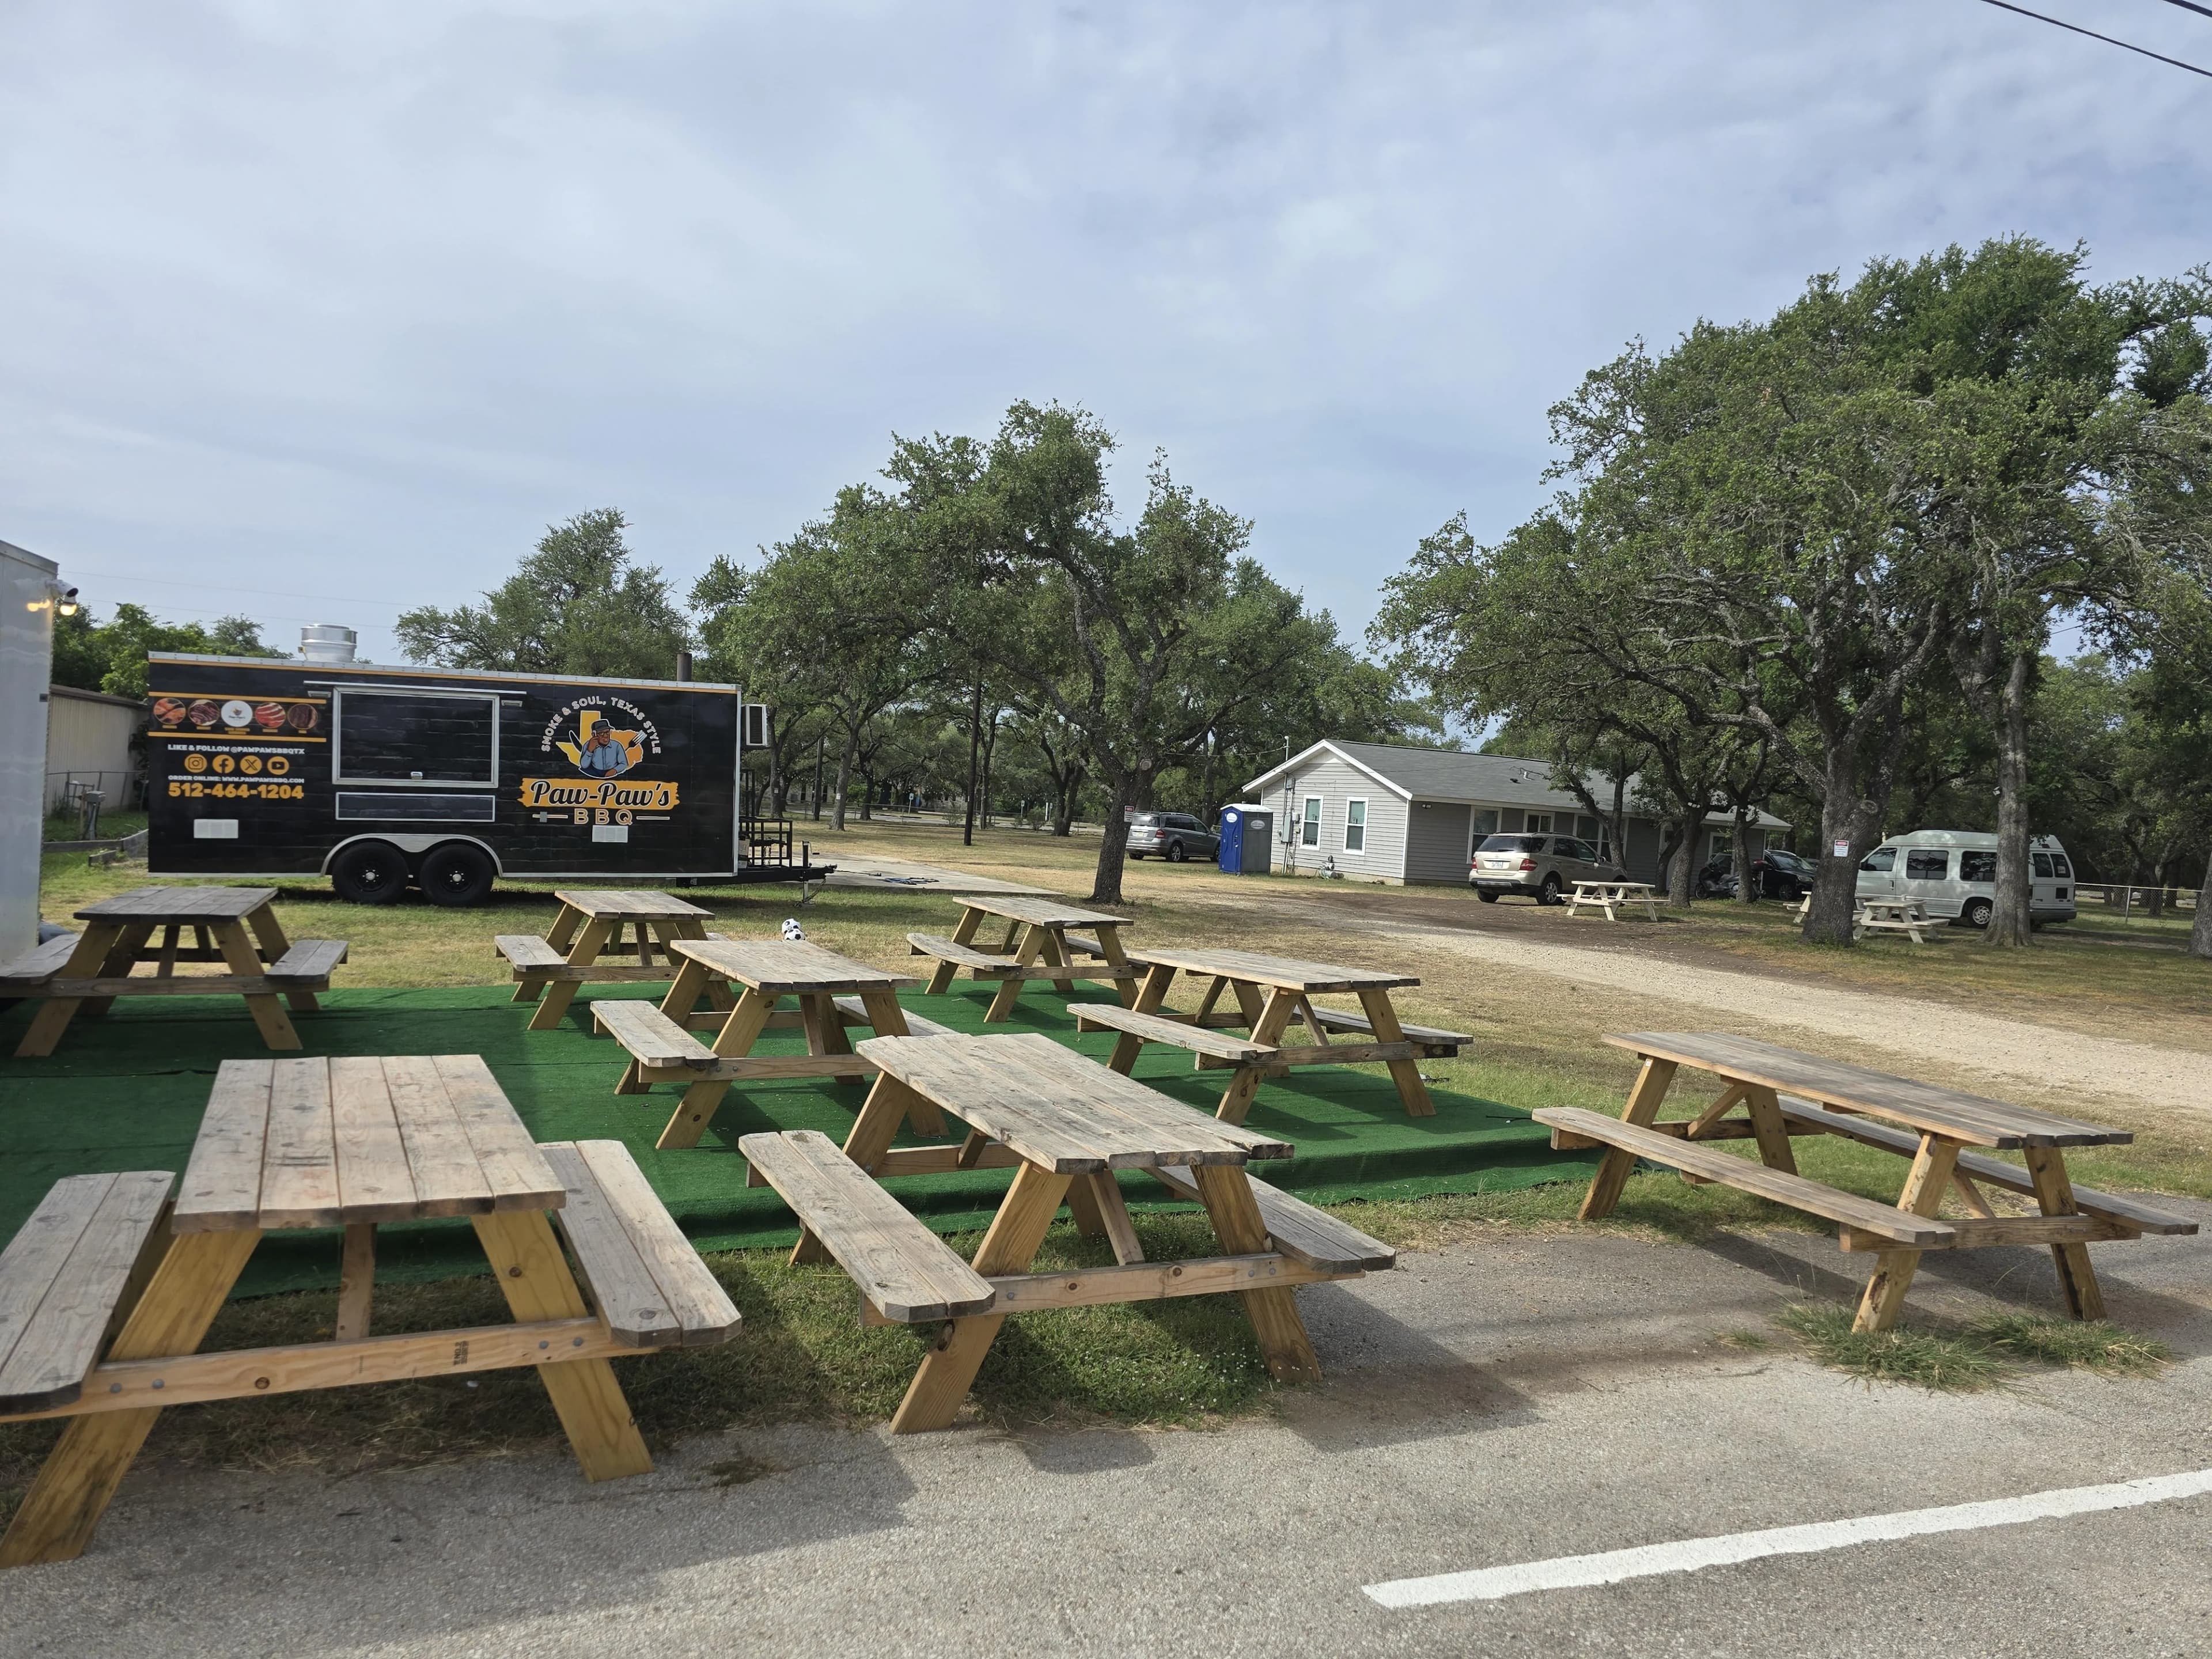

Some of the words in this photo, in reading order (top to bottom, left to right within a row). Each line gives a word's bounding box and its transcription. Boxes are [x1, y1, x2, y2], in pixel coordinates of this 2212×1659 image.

[541, 714, 563, 752] SMOKE
[562, 707, 571, 715] &
[571, 696, 606, 709] SOUL,
[611, 697, 645, 720] TEXAS
[643, 721, 661, 754] STYLE
[168, 782, 304, 799] 512-464-1204
[530, 780, 671, 807] Paw-Paw's
